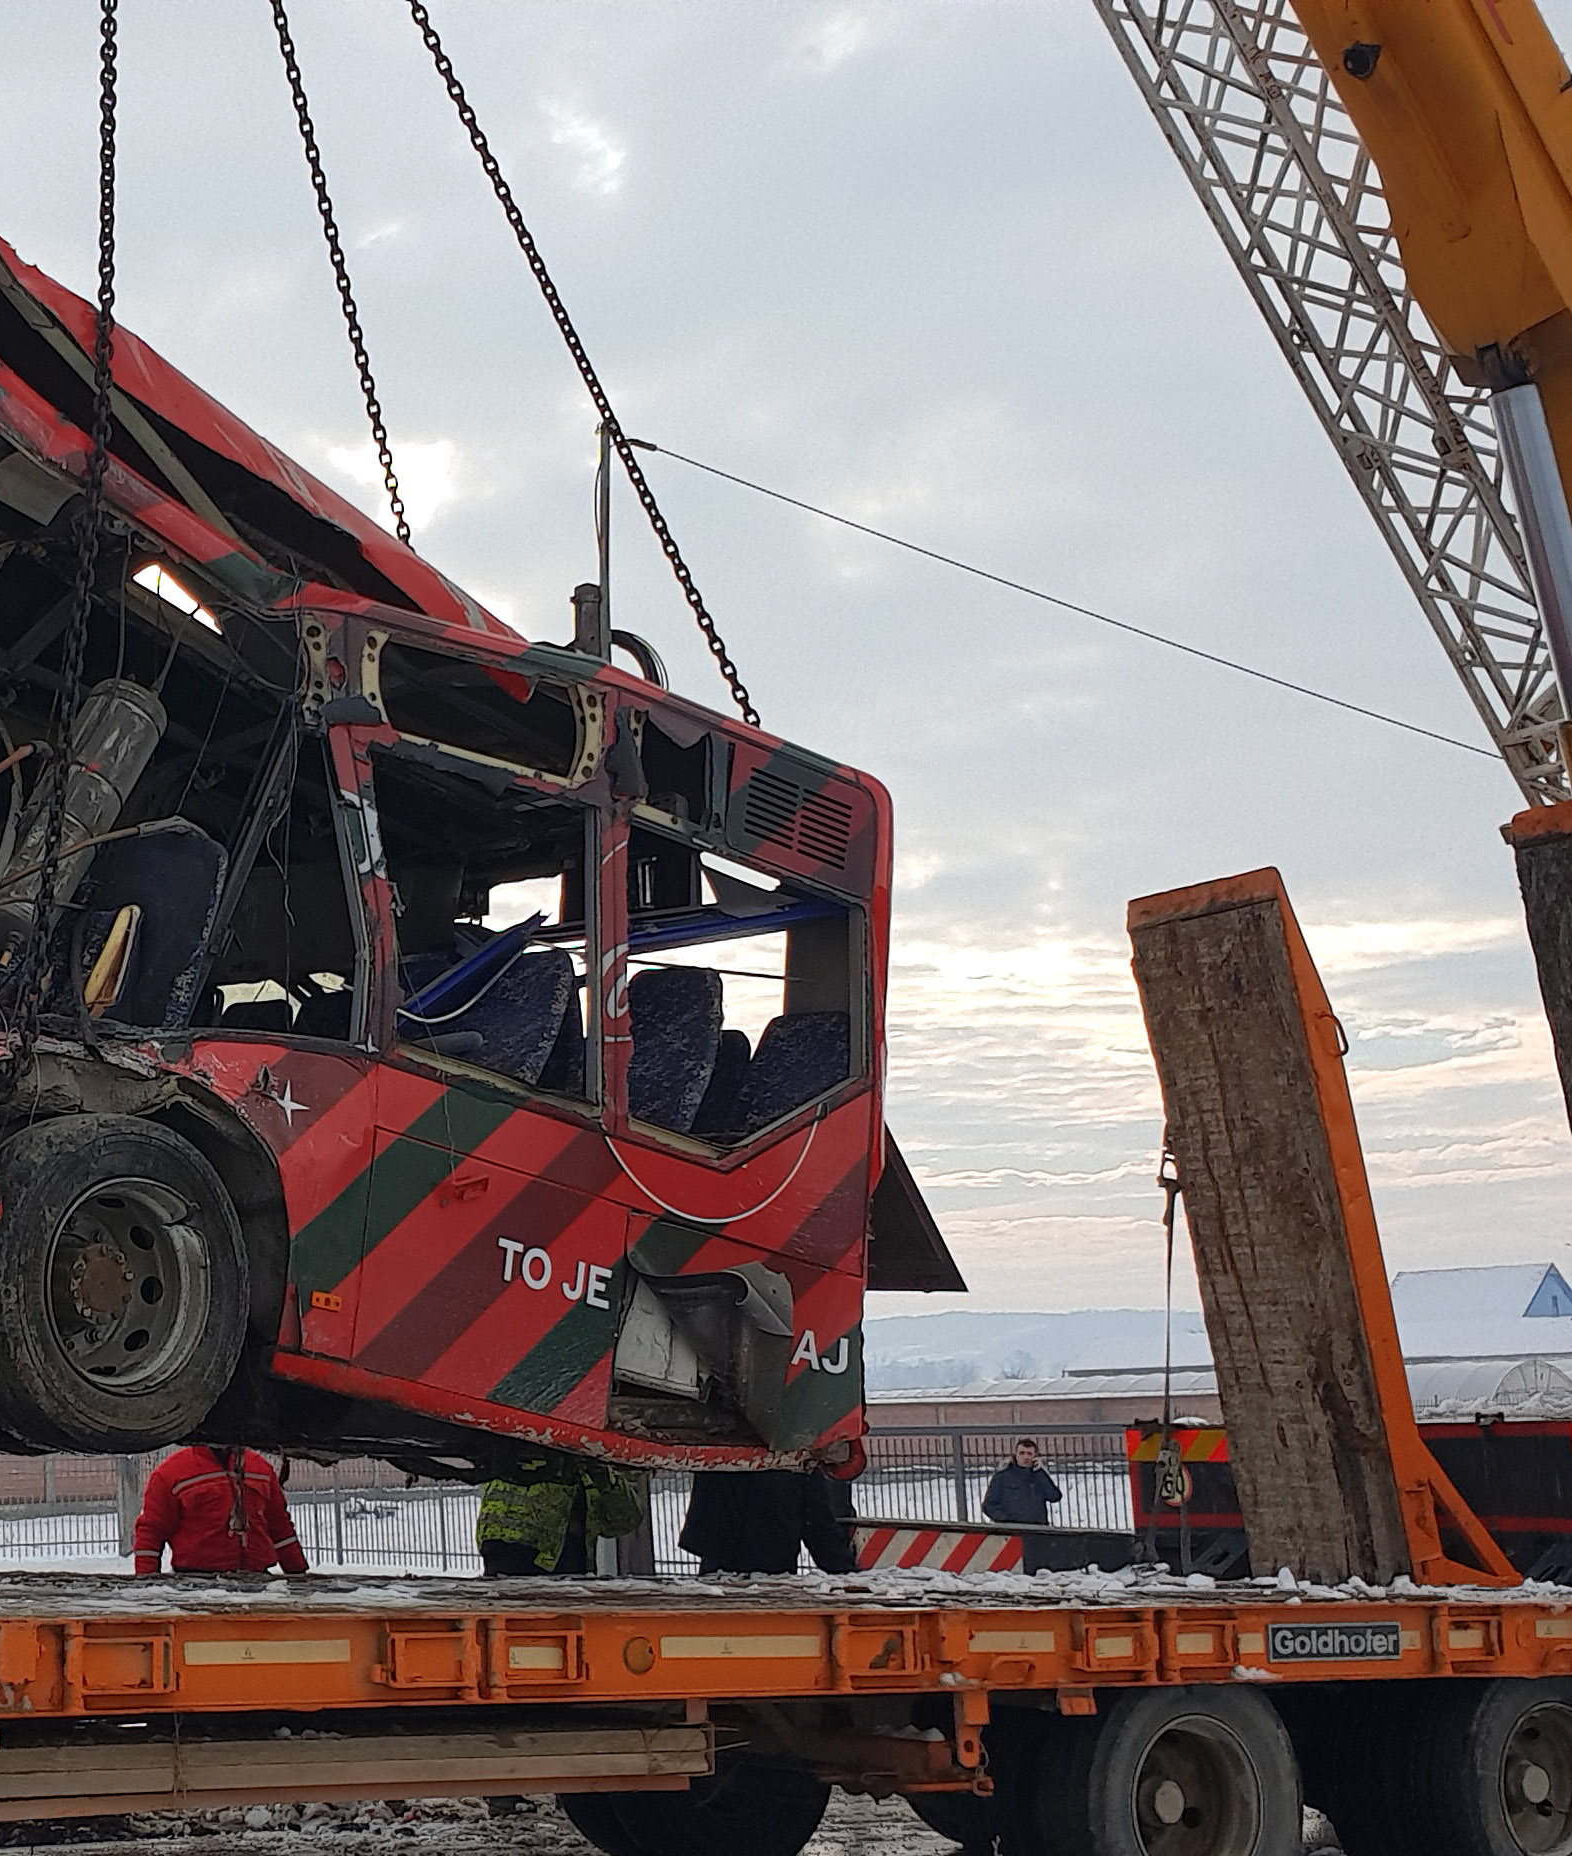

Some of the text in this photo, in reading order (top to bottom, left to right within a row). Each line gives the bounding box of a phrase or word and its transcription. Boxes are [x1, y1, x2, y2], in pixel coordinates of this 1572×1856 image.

[498, 1237, 849, 1374] TO JE AJ
[1274, 1628, 1398, 1655] Goldhofer
